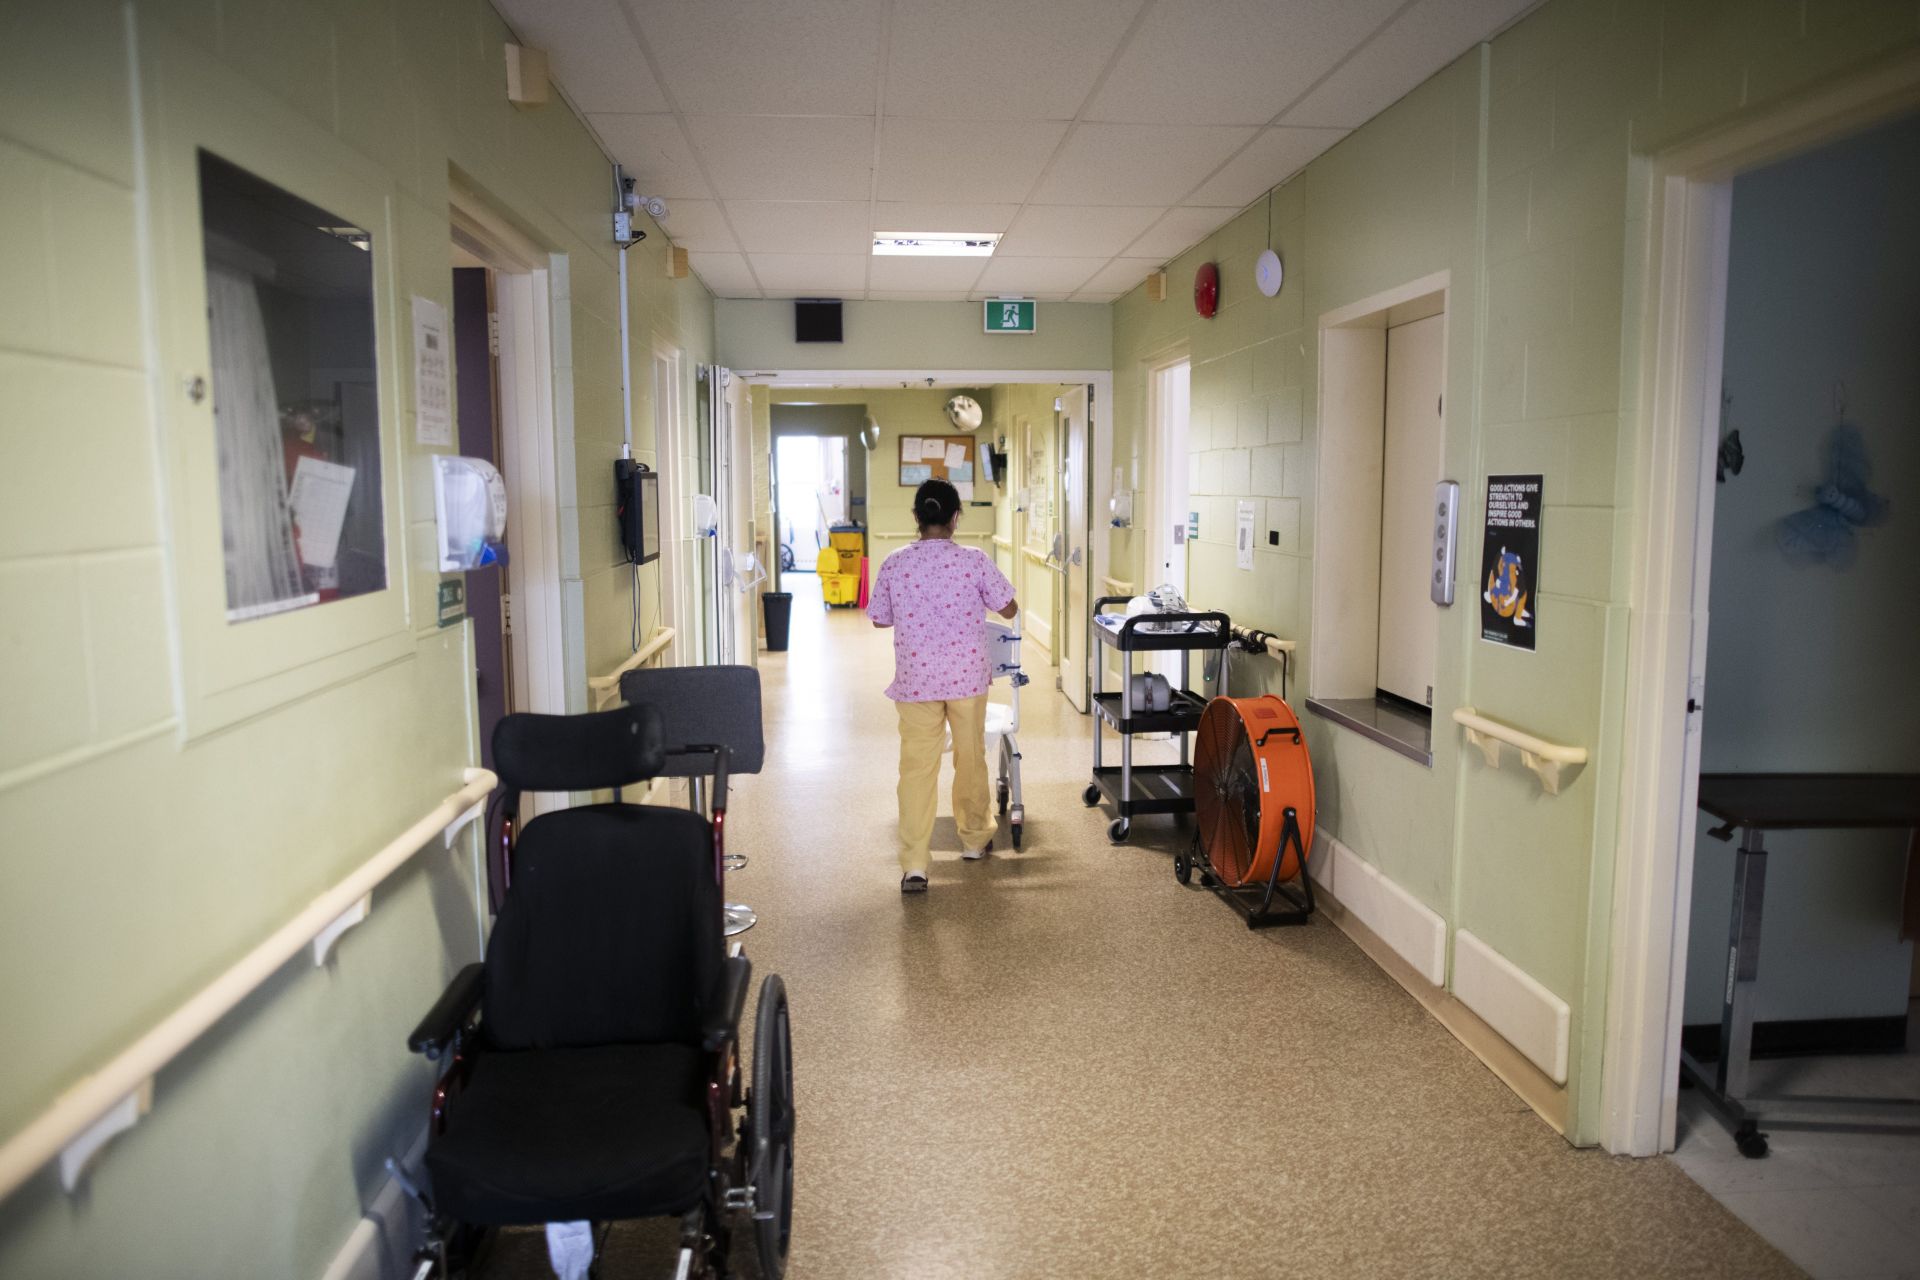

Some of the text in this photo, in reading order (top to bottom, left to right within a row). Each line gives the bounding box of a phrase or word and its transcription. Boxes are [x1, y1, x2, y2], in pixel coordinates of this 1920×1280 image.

[1490, 484, 1538, 492] GOOD ACTIONS GIVE
[1516, 493, 1523, 501] TO
[1489, 501, 1529, 510] OURSELVES AND
[1508, 510, 1522, 518] GOOD
[1487, 518, 1508, 526] ACTIONS
[1509, 519, 1515, 527] IN
